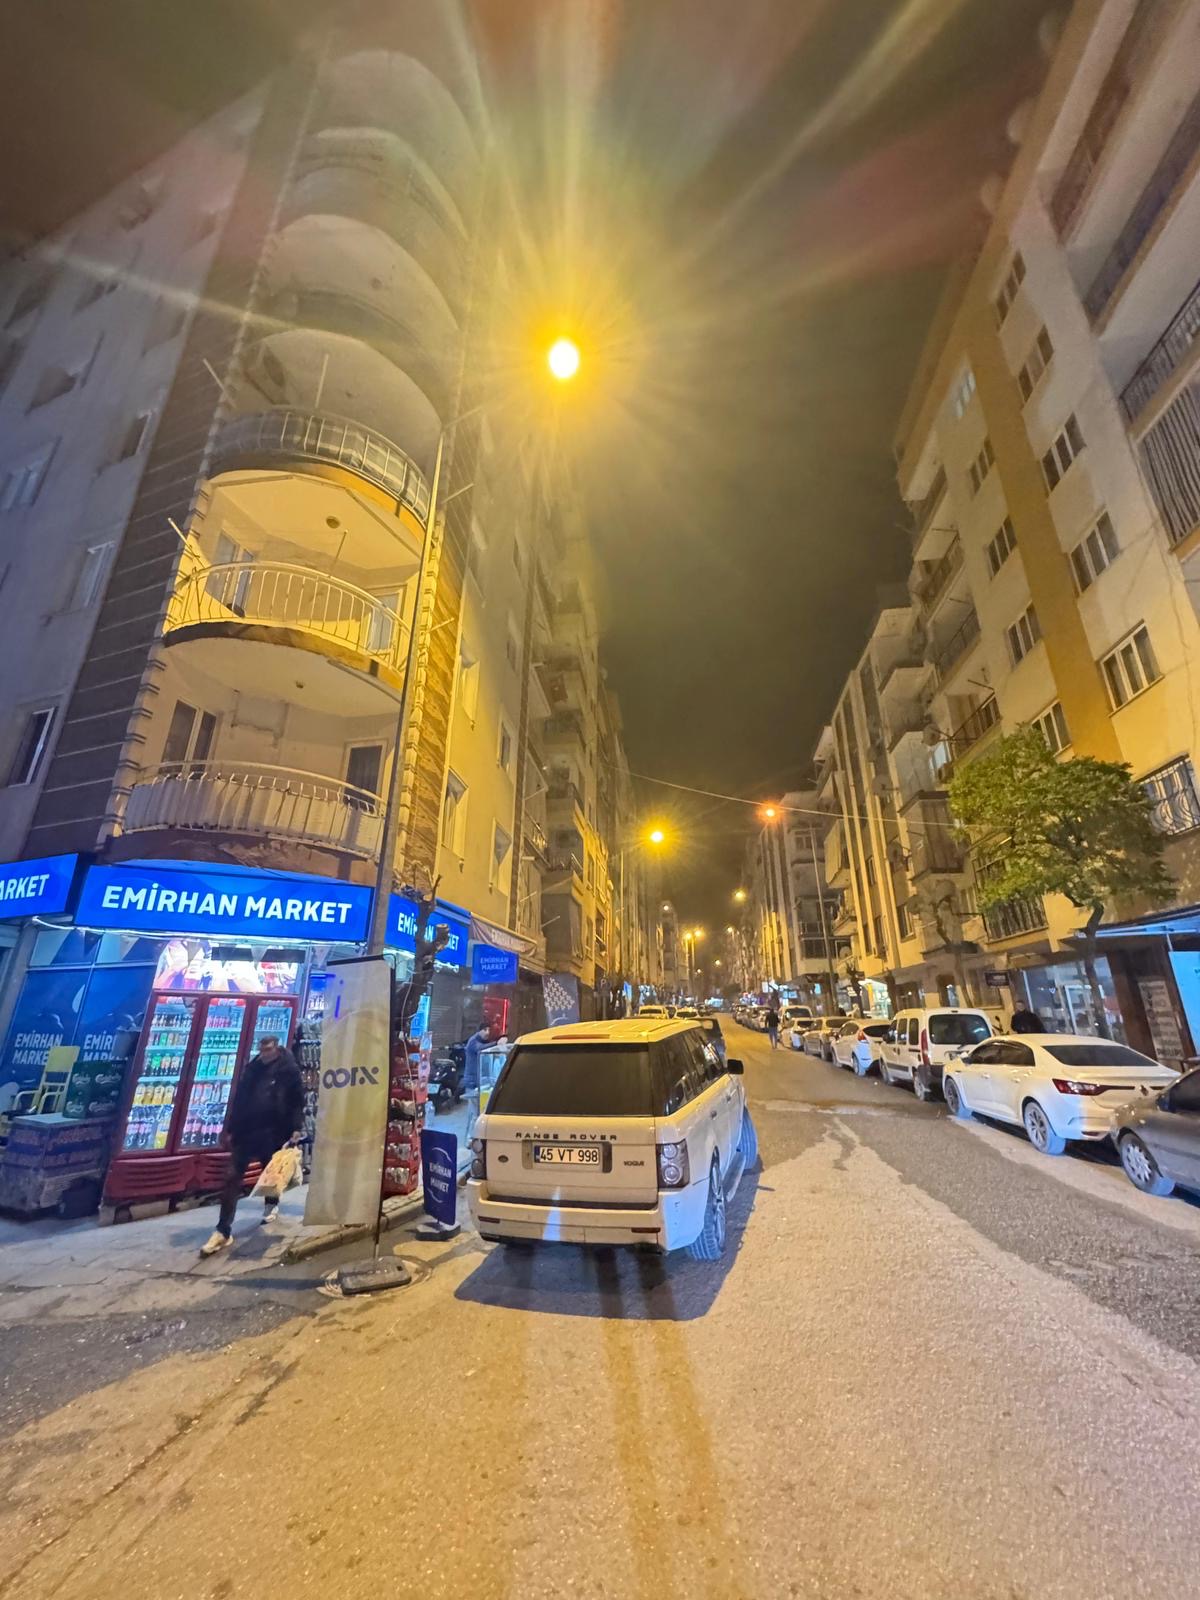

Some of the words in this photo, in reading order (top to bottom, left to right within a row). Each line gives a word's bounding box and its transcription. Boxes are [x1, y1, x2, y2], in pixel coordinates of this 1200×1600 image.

[101, 883, 237, 916] EMİRHAN
[244, 896, 352, 924] MARKET
[14, 1030, 63, 1050] EMİRHAN
[12, 1050, 49, 1065] MARKE
[515, 1132, 560, 1140] RANGE
[569, 1133, 617, 1141] ROVER
[540, 1148, 553, 1161] 45
[557, 1148, 574, 1162] VT
[577, 1149, 598, 1163] 998
